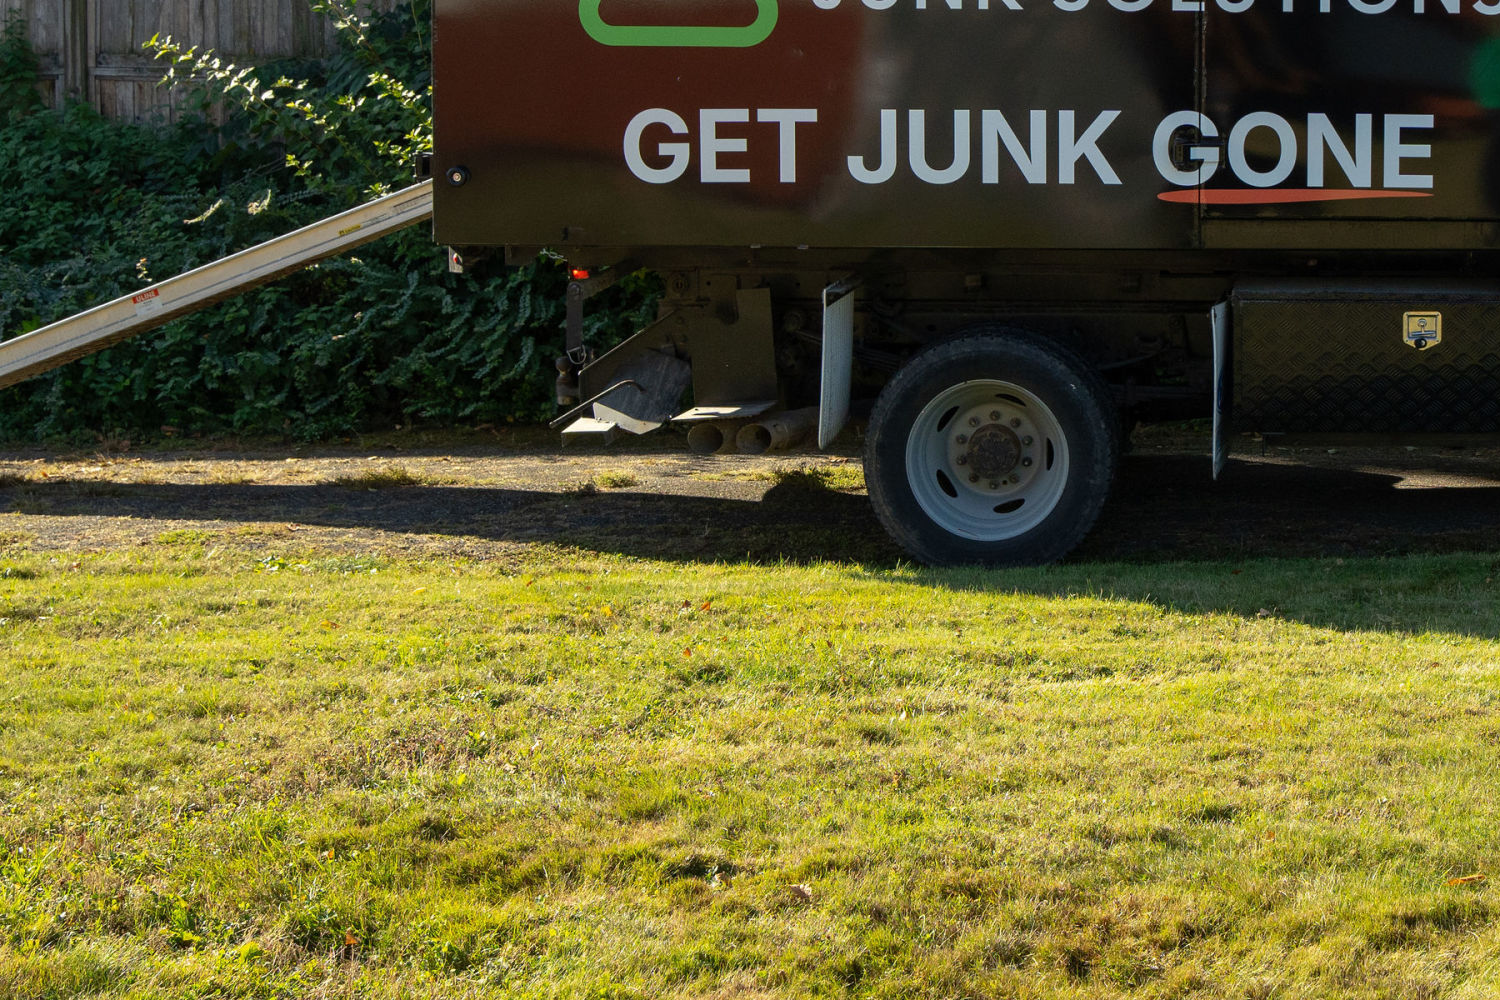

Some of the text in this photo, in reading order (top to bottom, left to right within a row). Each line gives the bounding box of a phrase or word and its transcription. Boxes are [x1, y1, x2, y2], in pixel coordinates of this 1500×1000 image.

[623, 107, 1434, 189] GET JUNK GONE
